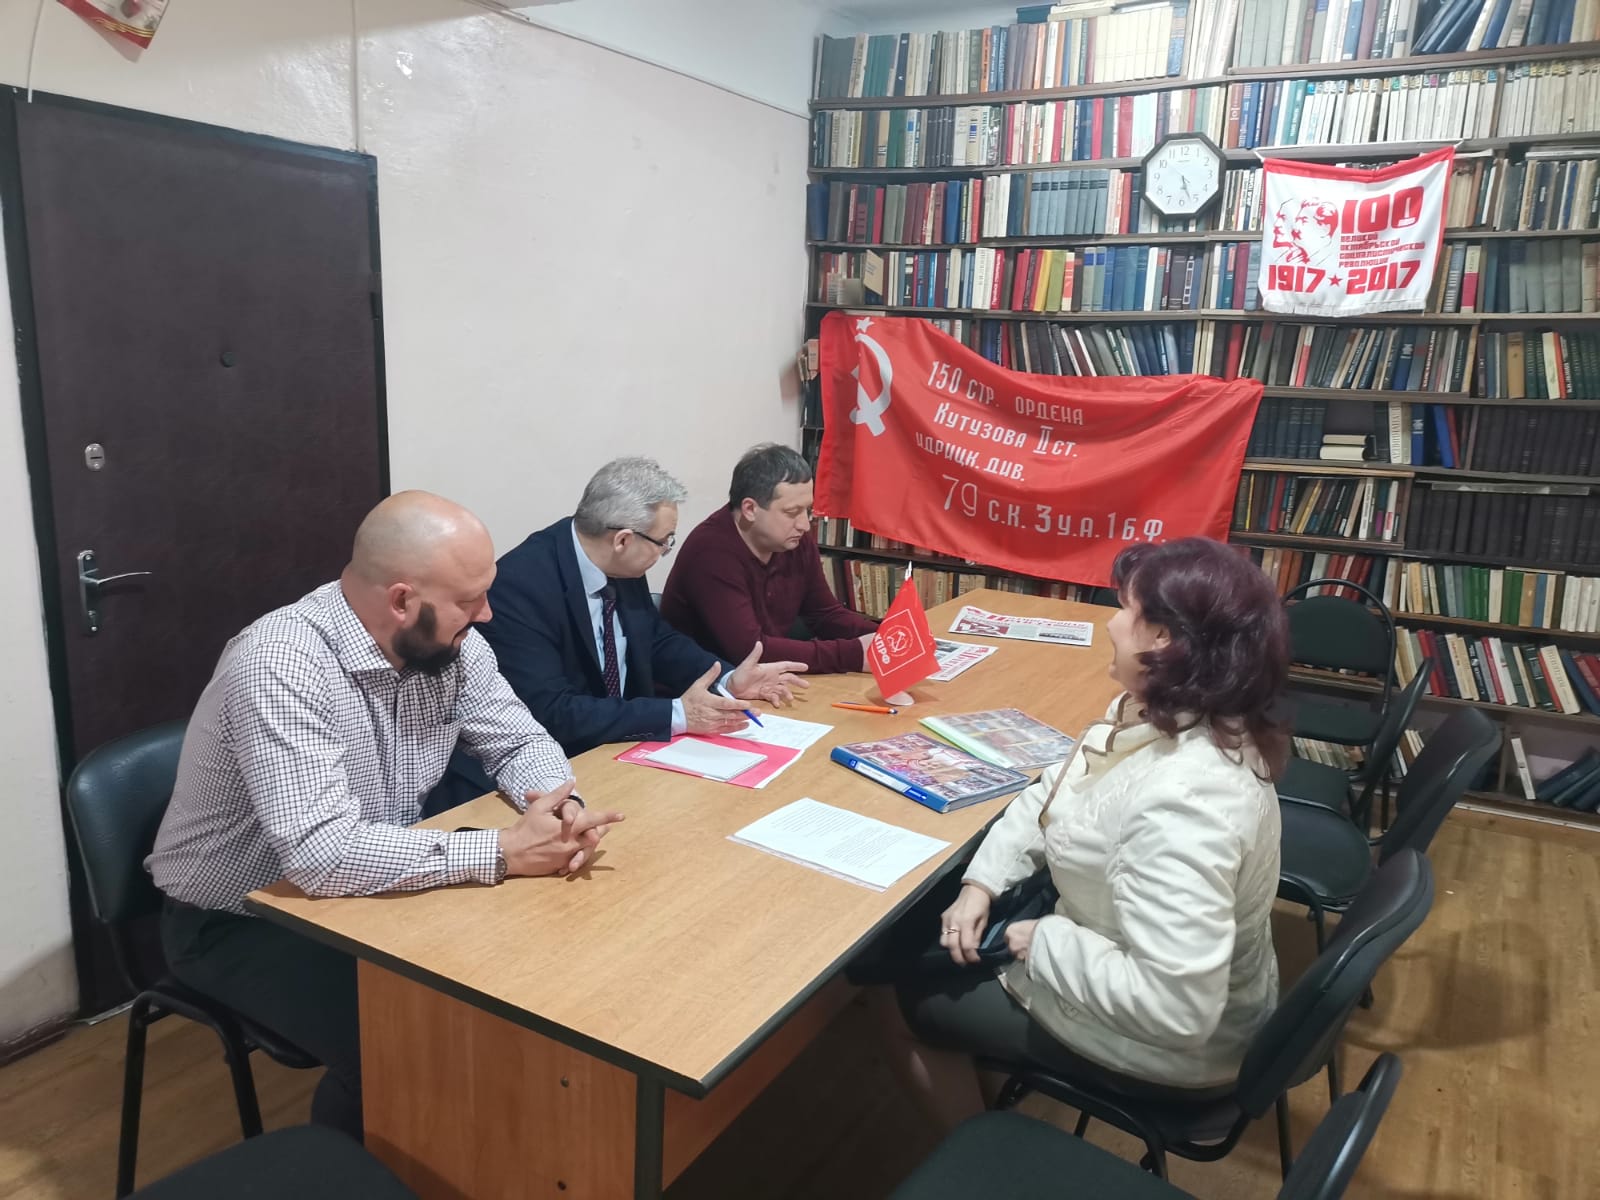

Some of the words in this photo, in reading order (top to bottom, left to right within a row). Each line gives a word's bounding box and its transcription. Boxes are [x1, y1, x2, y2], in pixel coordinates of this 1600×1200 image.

[1168, 148, 1176, 159] 11
[1180, 146, 1190, 156] 12
[1159, 159, 1168, 169] 10
[1203, 157, 1210, 167] 2
[1153, 172, 1160, 180] 9
[1202, 183, 1208, 192] 4
[1166, 195, 1172, 205] 7
[1192, 193, 1199, 202] 5
[1178, 199, 1185, 207] 6
[1341, 185, 1425, 234] 100
[1267, 264, 1326, 294] 1917
[1346, 260, 1421, 295] 2017
[927, 360, 963, 394] 150
[1015, 396, 1084, 425] ОРДЕНА
[942, 474, 978, 517] 79
[875, 633, 890, 664] КПРФ
